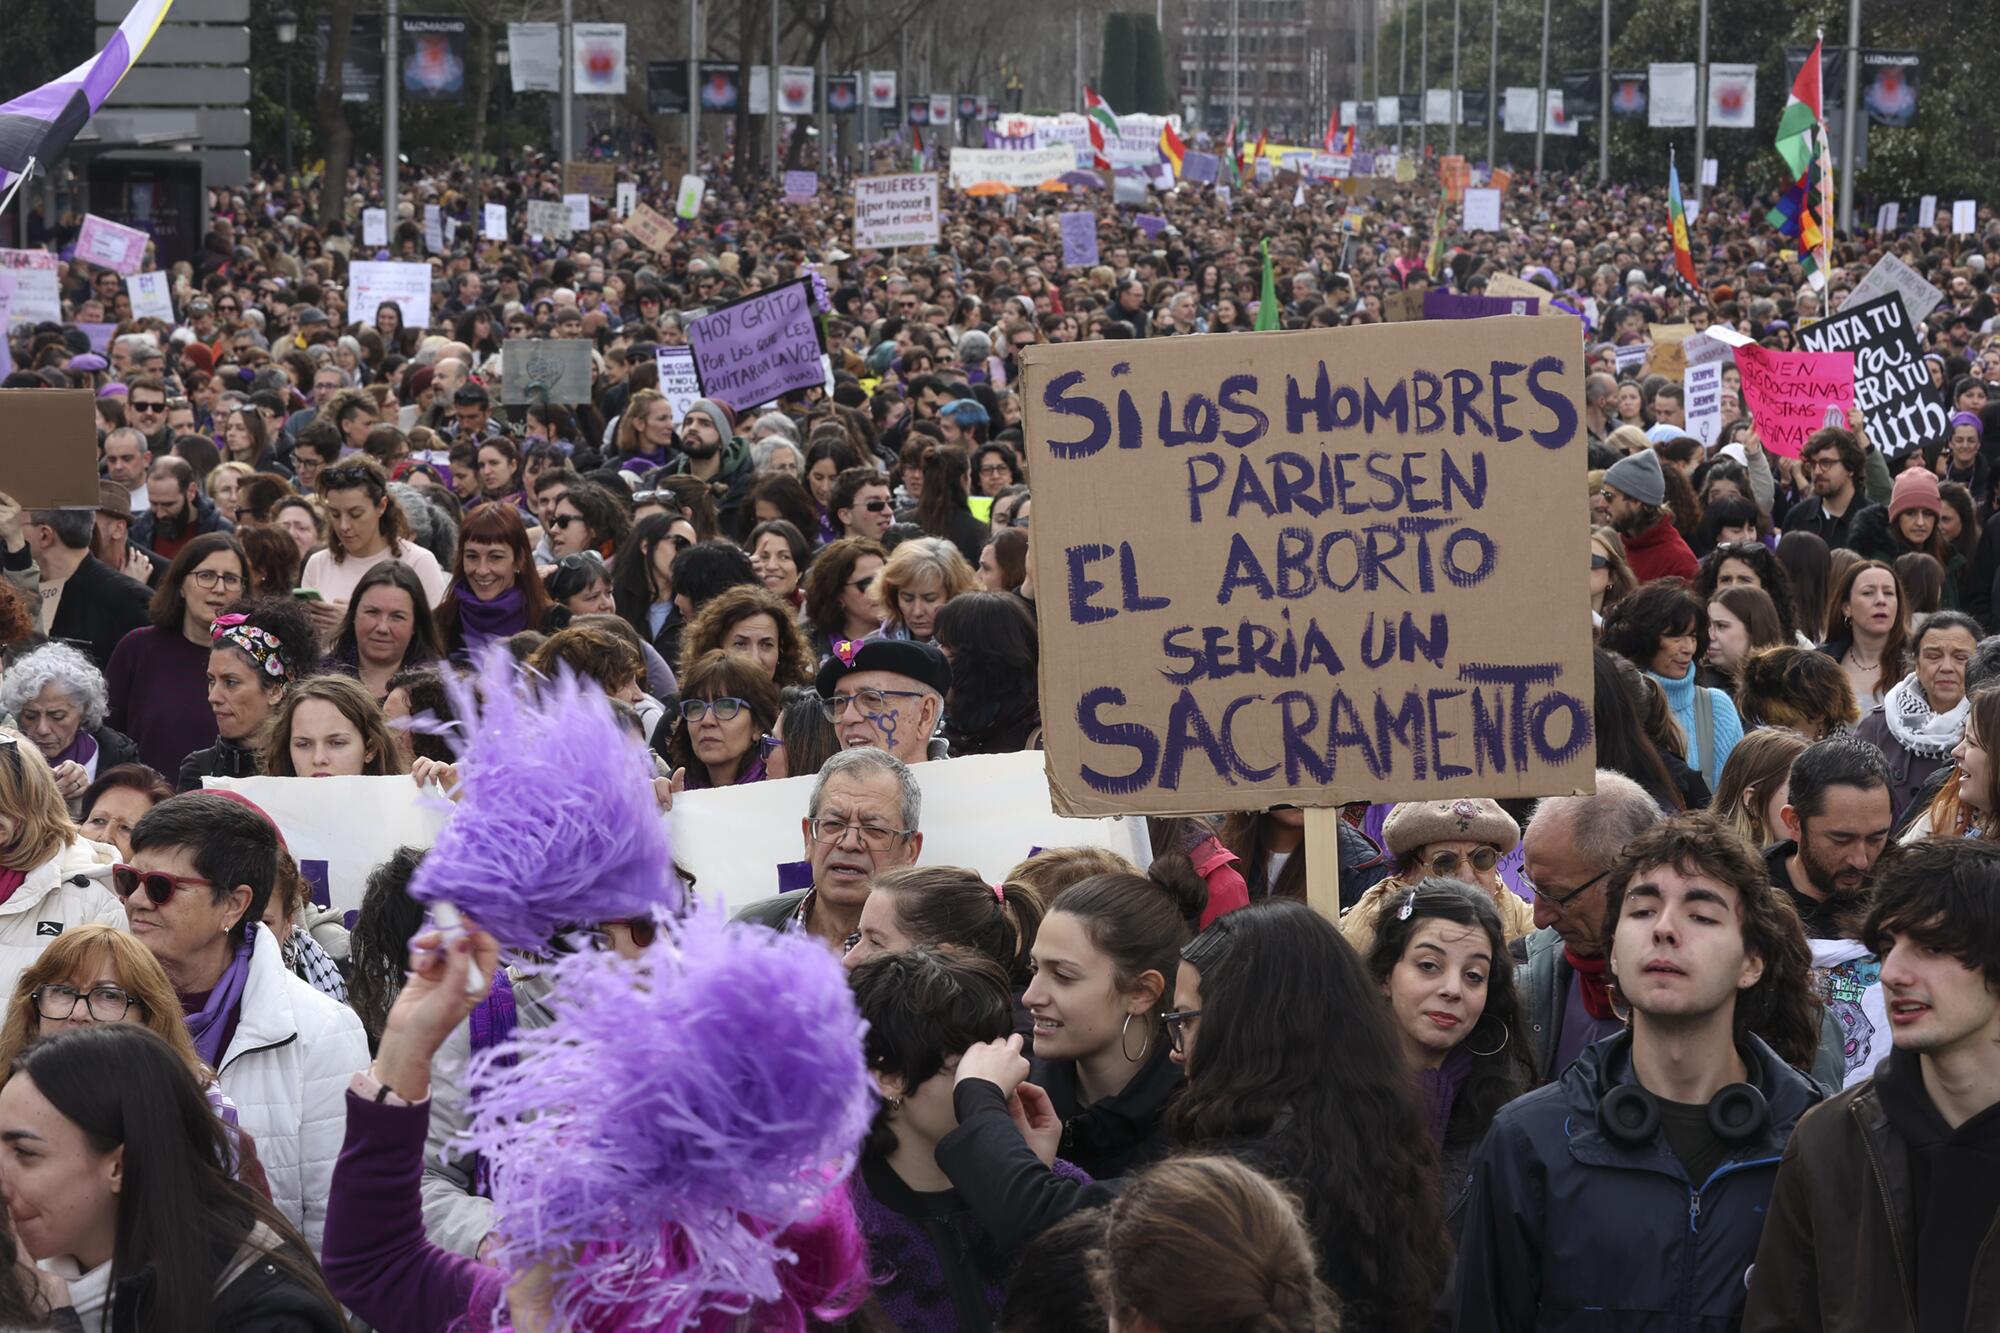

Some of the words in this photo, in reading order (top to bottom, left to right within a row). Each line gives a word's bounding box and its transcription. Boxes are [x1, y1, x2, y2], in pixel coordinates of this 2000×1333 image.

[697, 312, 732, 344] HOY
[740, 292, 800, 329] GRITO
[1802, 314, 1872, 353] MATA
[1865, 302, 1901, 334] TU
[701, 352, 726, 373] POR
[730, 345, 753, 362] LAS
[757, 333, 778, 353] QUE
[784, 321, 811, 338] LES
[703, 359, 771, 396] QUITARON
[772, 352, 788, 368] LA
[786, 341, 820, 366] VOZ
[675, 377, 688, 385] NO
[1692, 368, 1715, 382] SIEMPRE
[1693, 392, 1716, 407] SIEMPRE
[1898, 359, 1930, 391] TU
[1159, 374, 1269, 448] LOS
[1285, 355, 1579, 450] HOMBRES
[1186, 446, 1488, 523] PARIESEN
[1065, 540, 1171, 625] EL
[1216, 516, 1499, 605] ABORTO
[1359, 609, 1449, 669] UN
[1074, 662, 1594, 796] SACRAMENTO
